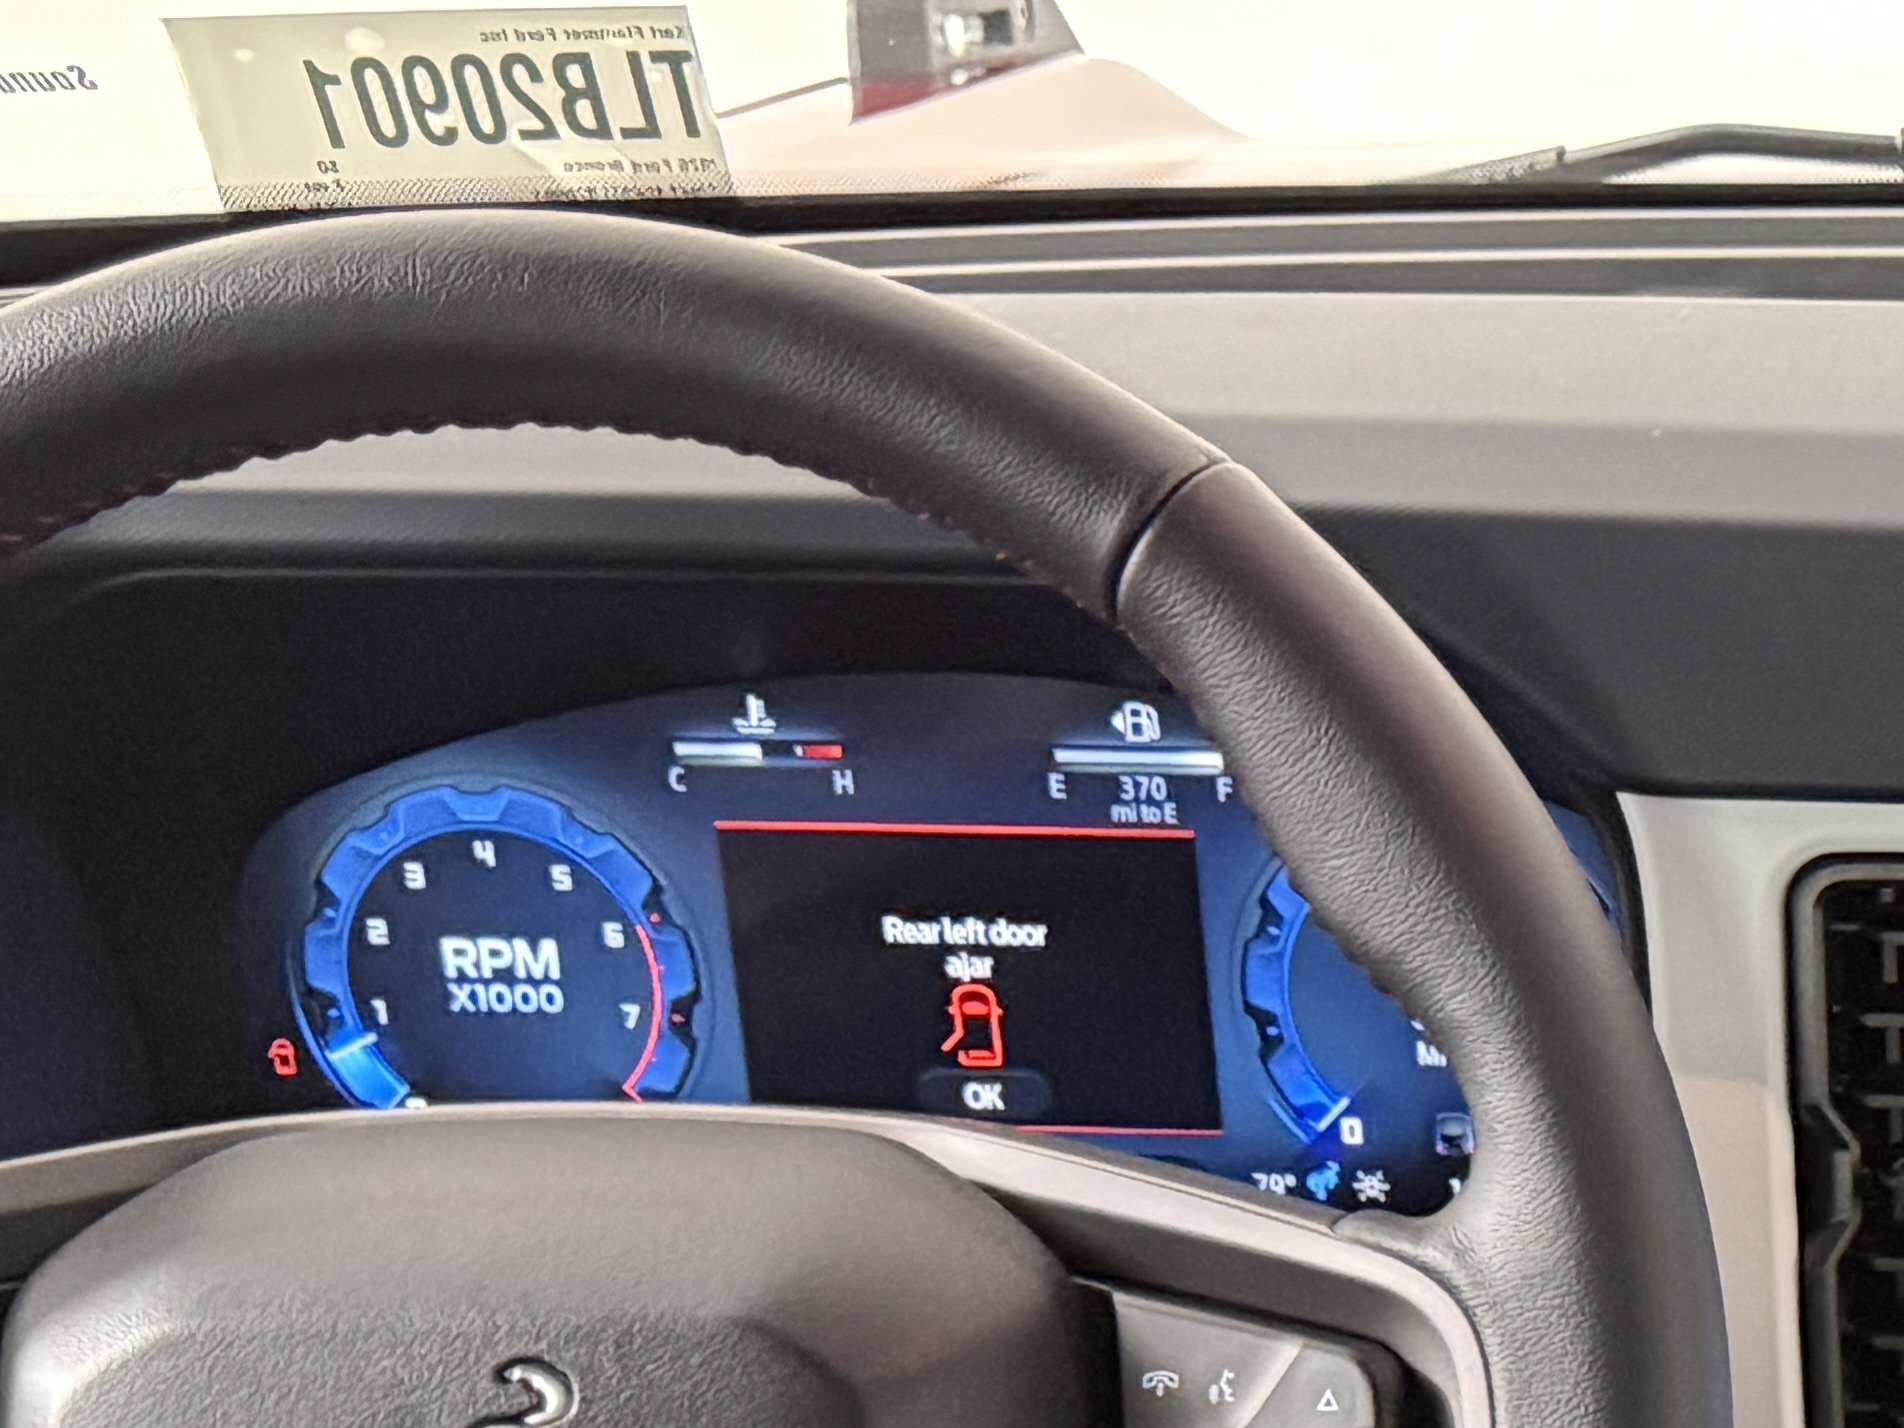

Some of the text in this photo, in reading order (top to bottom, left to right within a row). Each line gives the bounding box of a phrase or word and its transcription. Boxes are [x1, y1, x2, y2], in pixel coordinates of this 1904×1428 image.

[667, 767, 688, 792] C
[832, 769, 855, 796] H
[1049, 775, 1067, 800] E
[1119, 777, 1167, 801] 370
[1217, 777, 1233, 802] F
[1110, 803, 1177, 824] mi to E
[472, 840, 497, 868] 4
[402, 862, 427, 890] 3
[549, 864, 574, 892] 5
[365, 917, 390, 945] 2
[602, 921, 626, 948] 6
[881, 917, 1047, 948] Rear left door
[439, 936, 562, 981] RPM
[945, 953, 995, 980] ajar
[370, 999, 389, 1026] 1
[448, 983, 564, 1015] X1000
[619, 1002, 641, 1029] 7
[962, 1084, 1004, 1111] OK
[1340, 1117, 1363, 1145] 0
